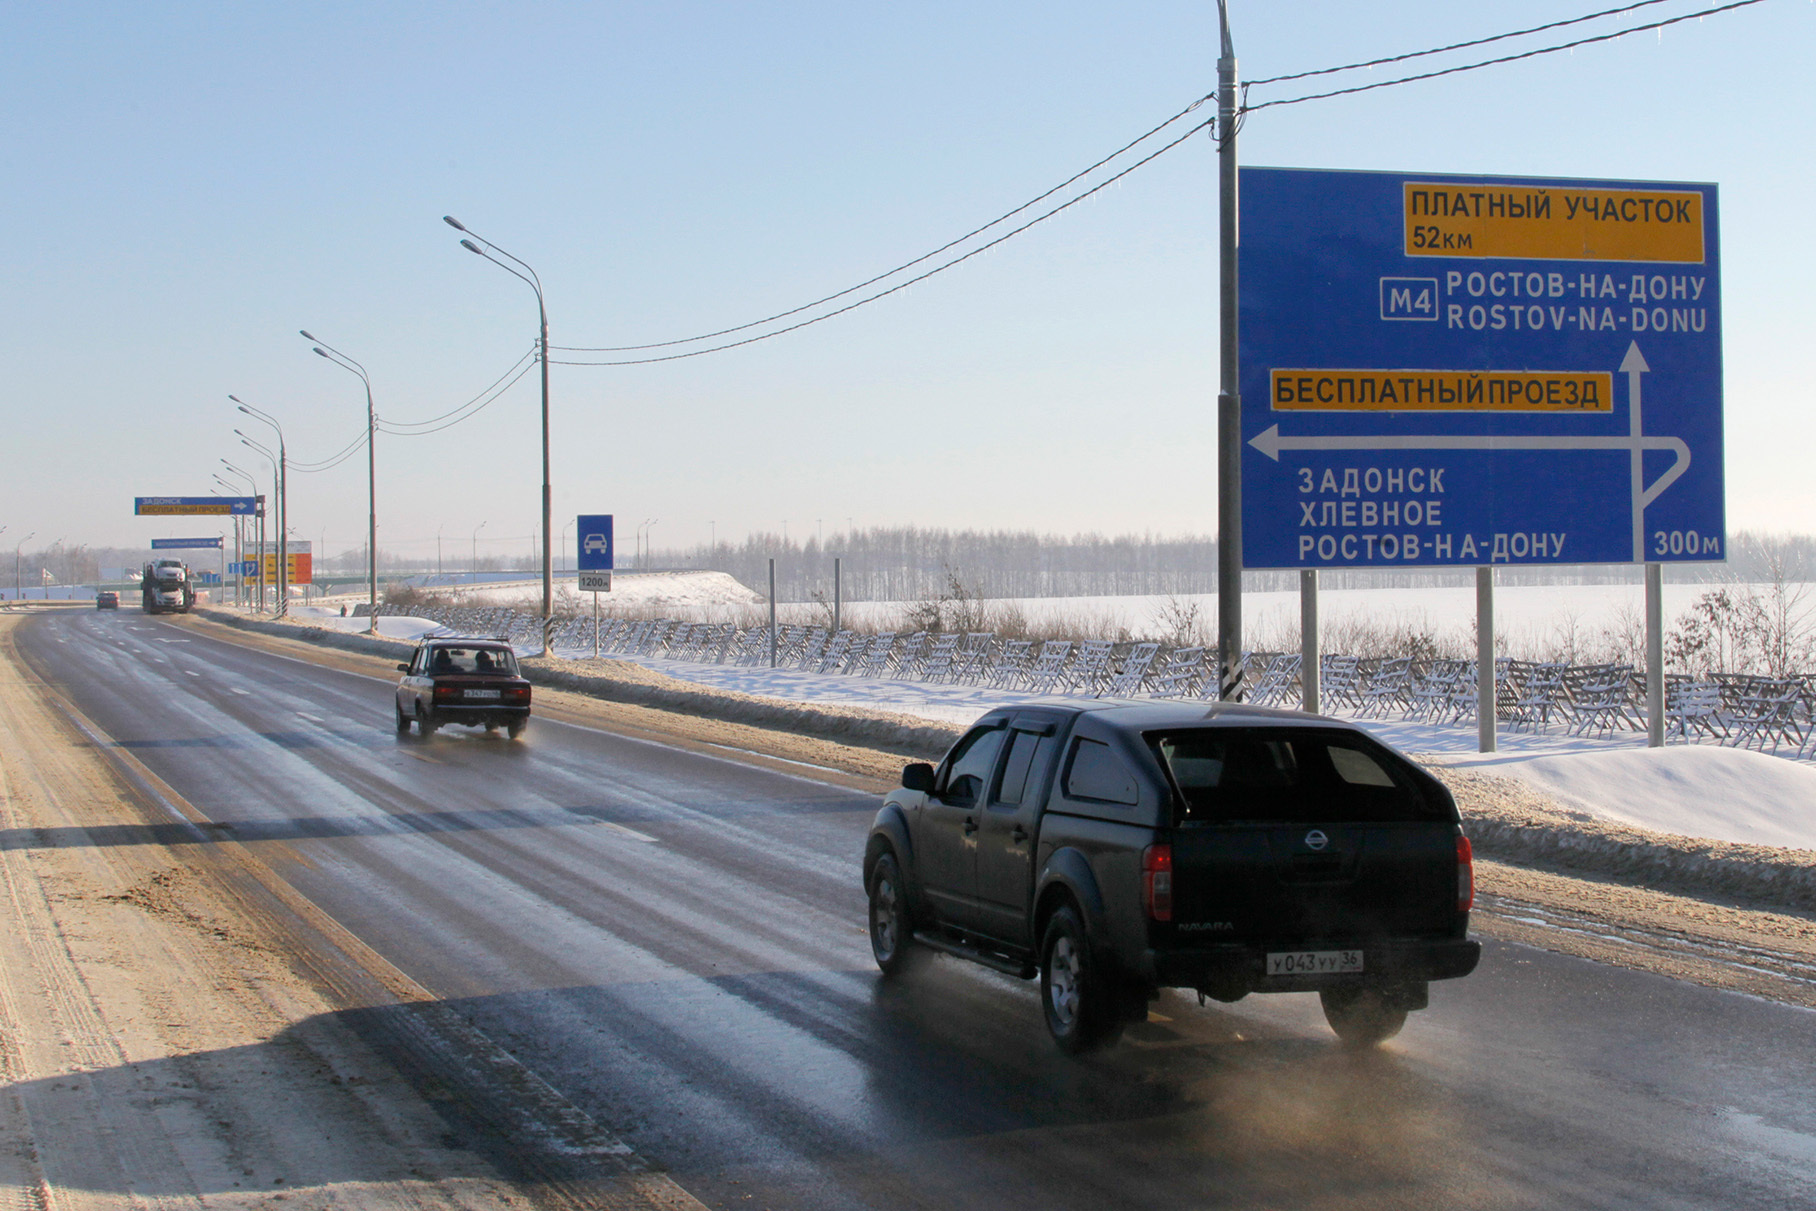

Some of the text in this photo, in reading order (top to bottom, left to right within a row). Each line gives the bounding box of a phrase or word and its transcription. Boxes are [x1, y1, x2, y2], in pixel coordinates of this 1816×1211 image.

[1412, 190, 1691, 224] ПЛАТНЫЙ УЧАСТОК
[1447, 271, 1706, 304] РОСТОВ-НА-ДОНУ
[1447, 304, 1706, 332] ROSTOV-NA-DONU
[1298, 467, 1445, 498] ЗАДОНСК
[1299, 501, 1442, 527] ХЛЕВНОЕ
[1178, 921, 1234, 932] NAVARA
